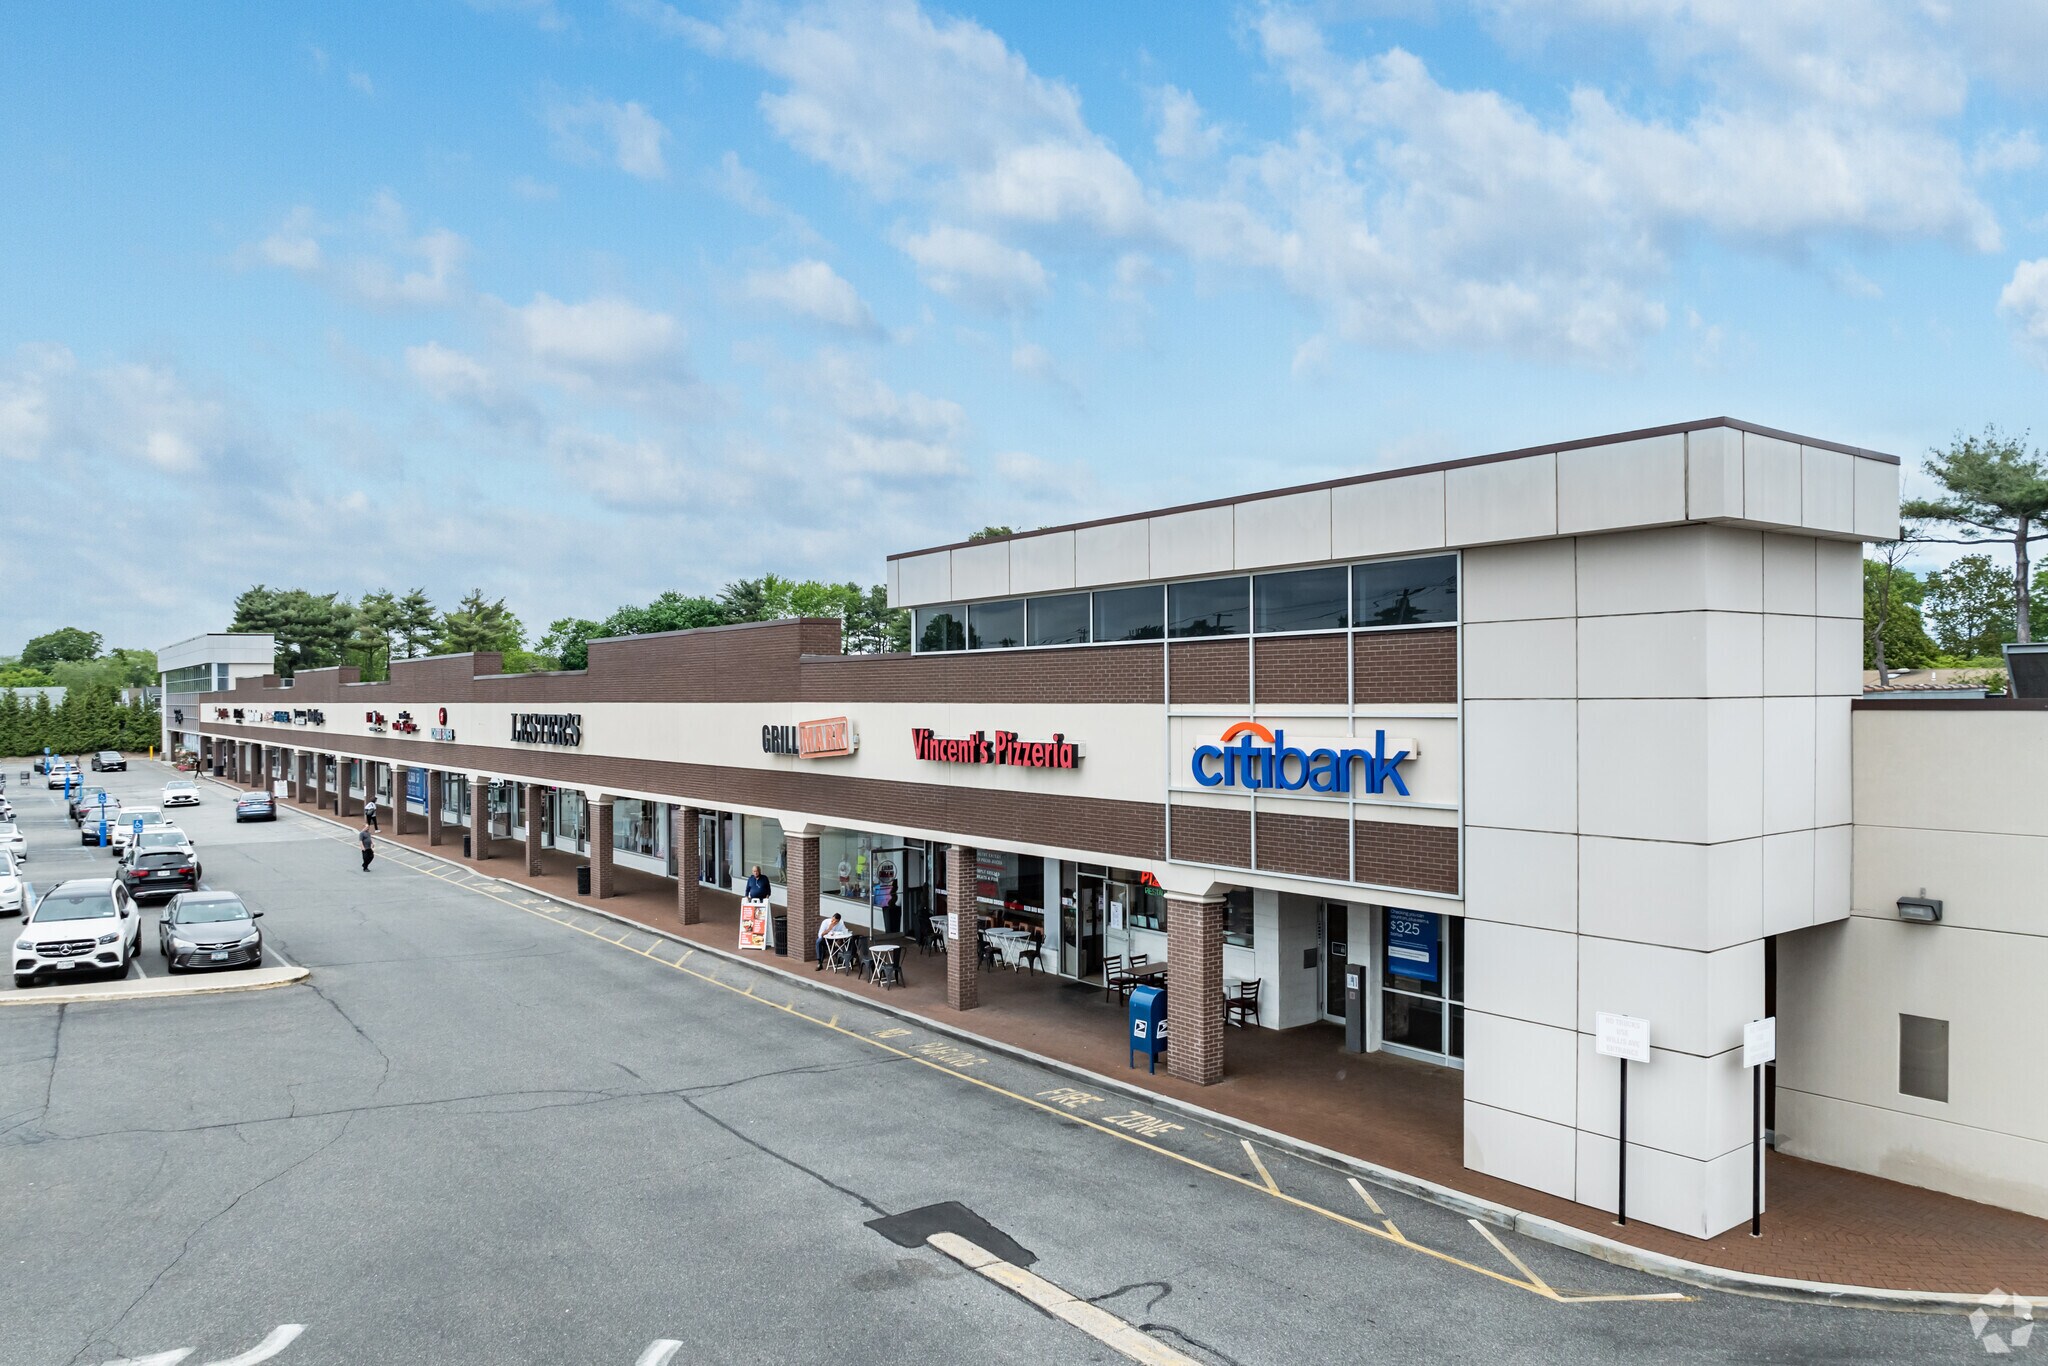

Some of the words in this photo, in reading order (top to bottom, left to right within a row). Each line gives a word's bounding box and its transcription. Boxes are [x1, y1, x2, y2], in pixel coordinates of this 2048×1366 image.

[511, 713, 581, 746] LESTER'S
[762, 724, 799, 755] GRILL
[801, 722, 846, 753] MARK
[911, 728, 994, 764] Vincent's
[995, 730, 1079, 769] Pizzeria
[1191, 724, 1411, 796] citibank
[1390, 920, 1420, 936] $325
[1036, 1087, 1106, 1109] FIRE
[1101, 1110, 1185, 1138] ZONE
